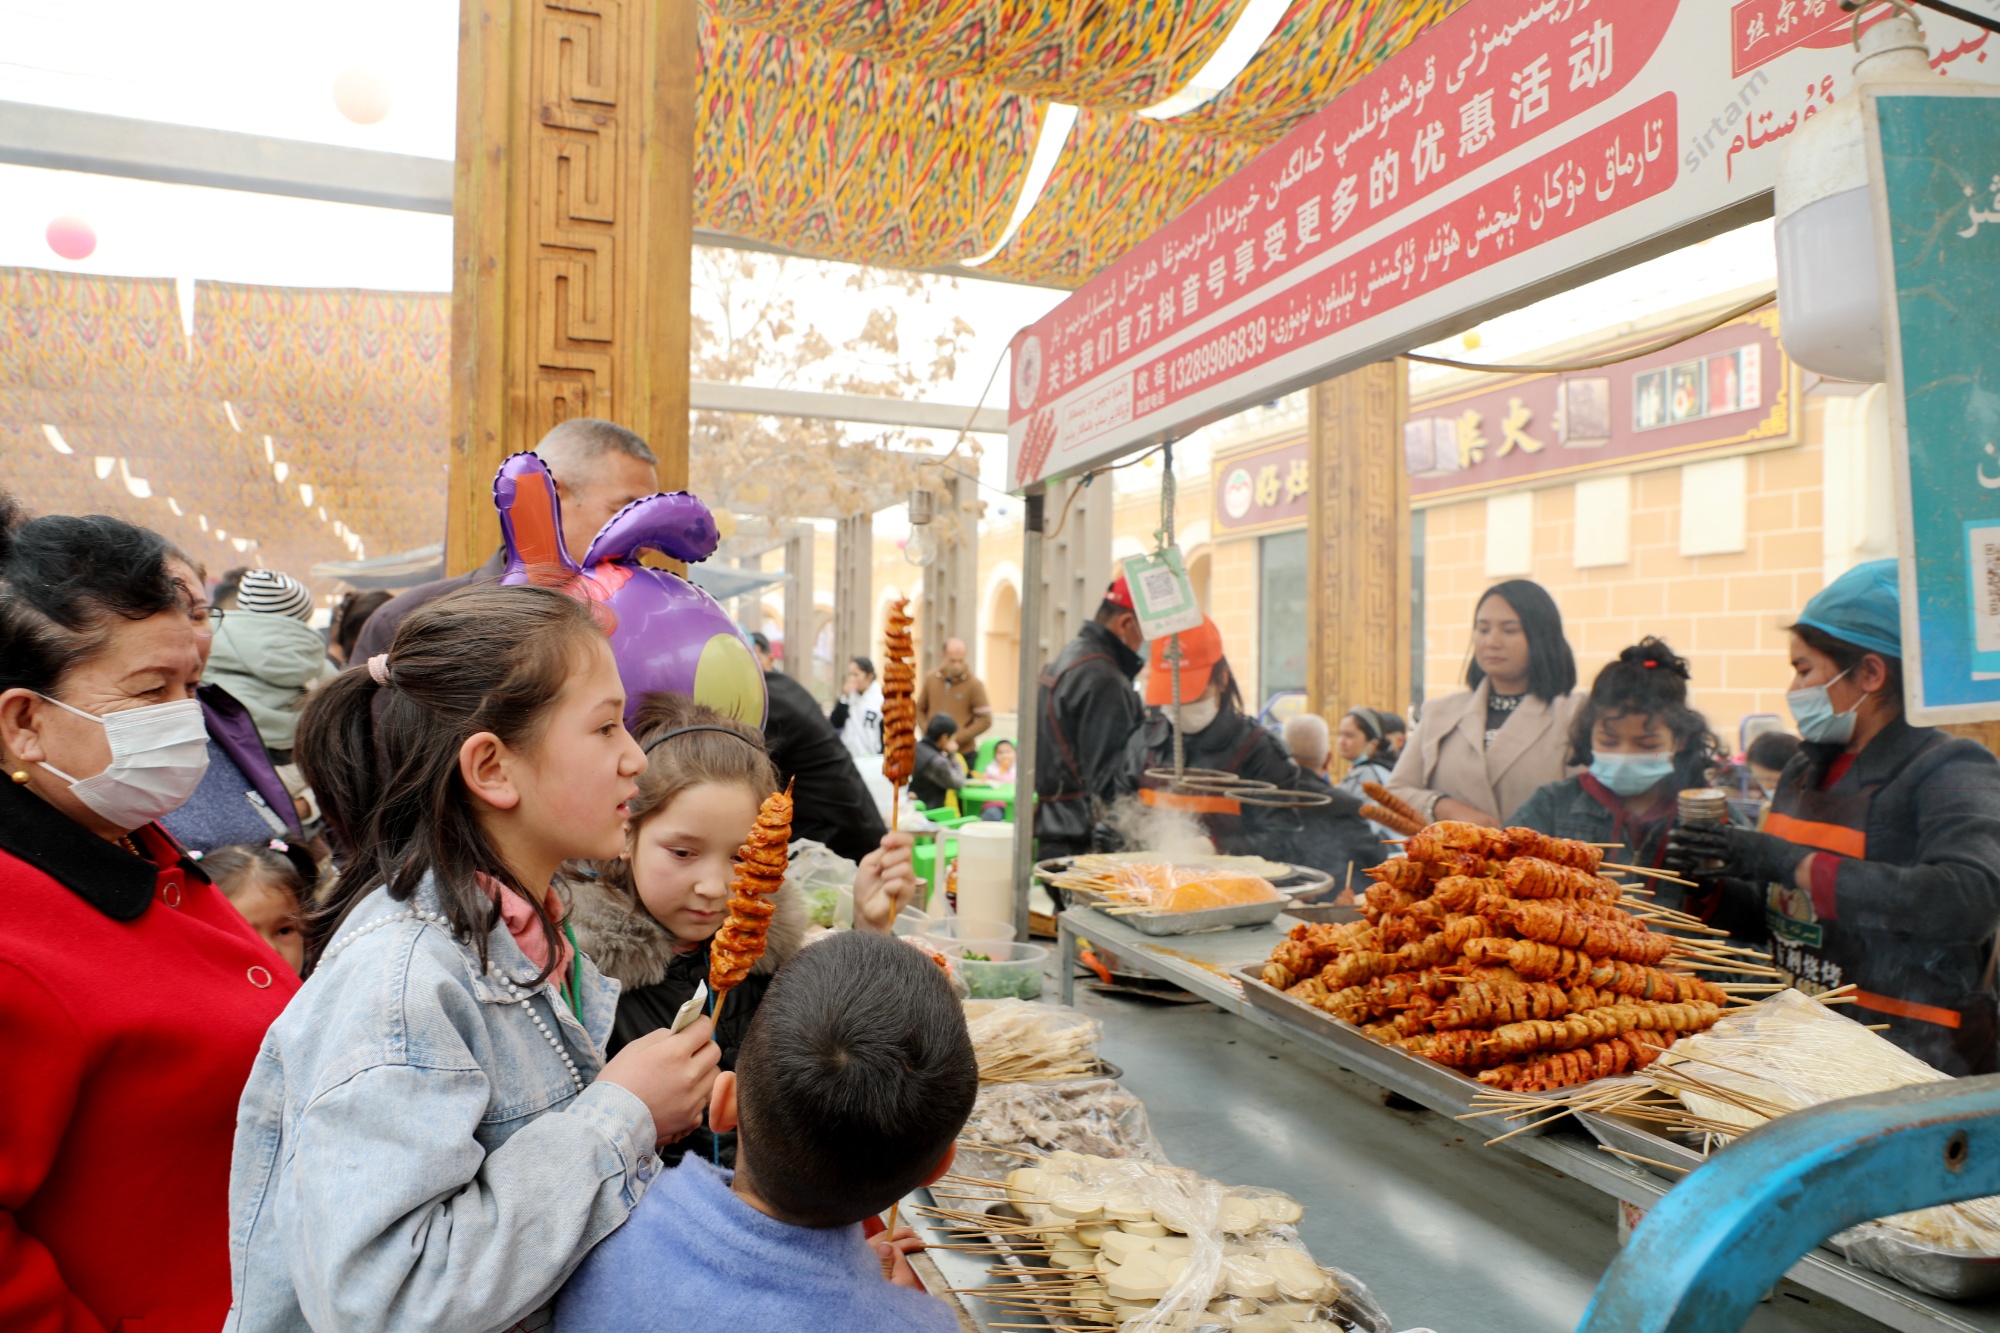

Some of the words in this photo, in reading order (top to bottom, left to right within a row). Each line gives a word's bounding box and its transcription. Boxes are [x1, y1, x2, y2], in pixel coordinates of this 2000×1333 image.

[1684, 69, 1770, 174] sirtam
[1048, 19, 1613, 395] 关注我们官方抖音号享受更多的优惠活动
[1169, 316, 1267, 393] 13289986839
